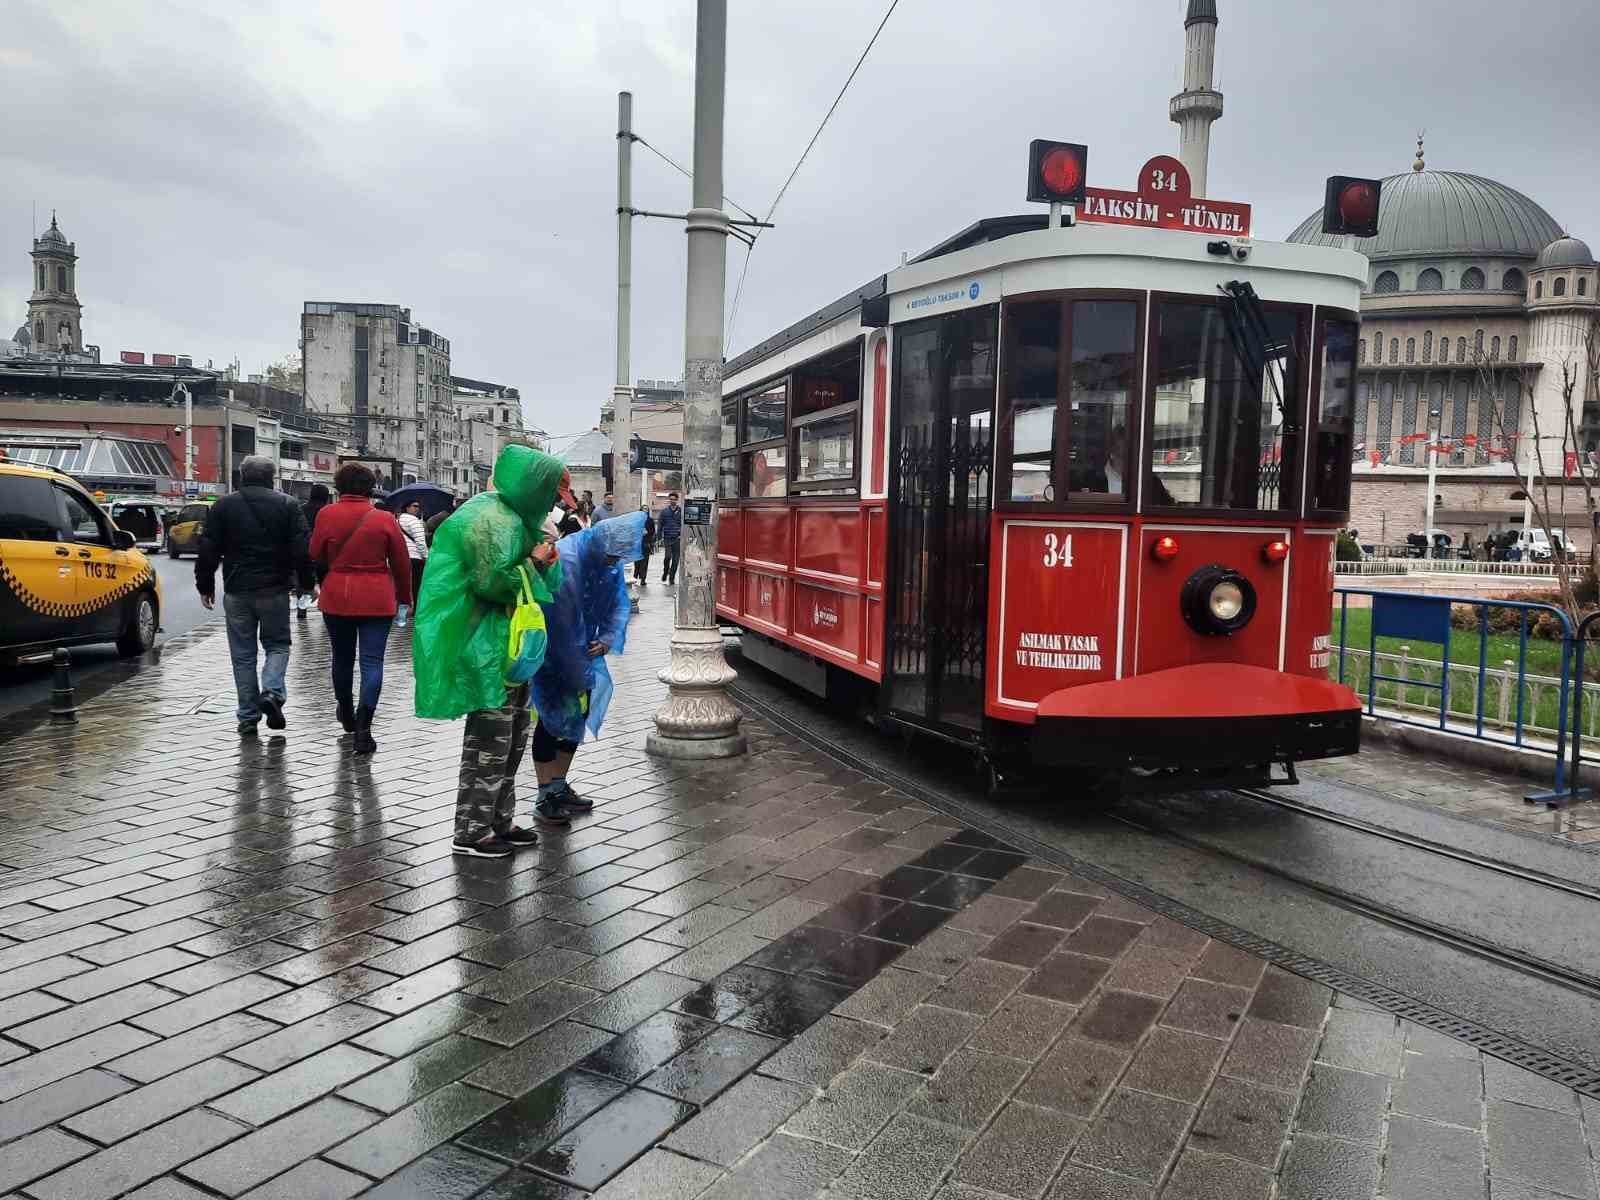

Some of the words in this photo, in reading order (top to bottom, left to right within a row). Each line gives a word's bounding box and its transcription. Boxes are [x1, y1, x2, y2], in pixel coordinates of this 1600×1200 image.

[1151, 169, 1178, 192] 34
[1181, 204, 1244, 232] TÜNEL
[1043, 533, 1073, 567] 34
[106, 563, 117, 579] 32
[1019, 632, 1061, 650] ASILMAK
[1063, 634, 1098, 651] YASAK
[1016, 649, 1029, 667] VE
